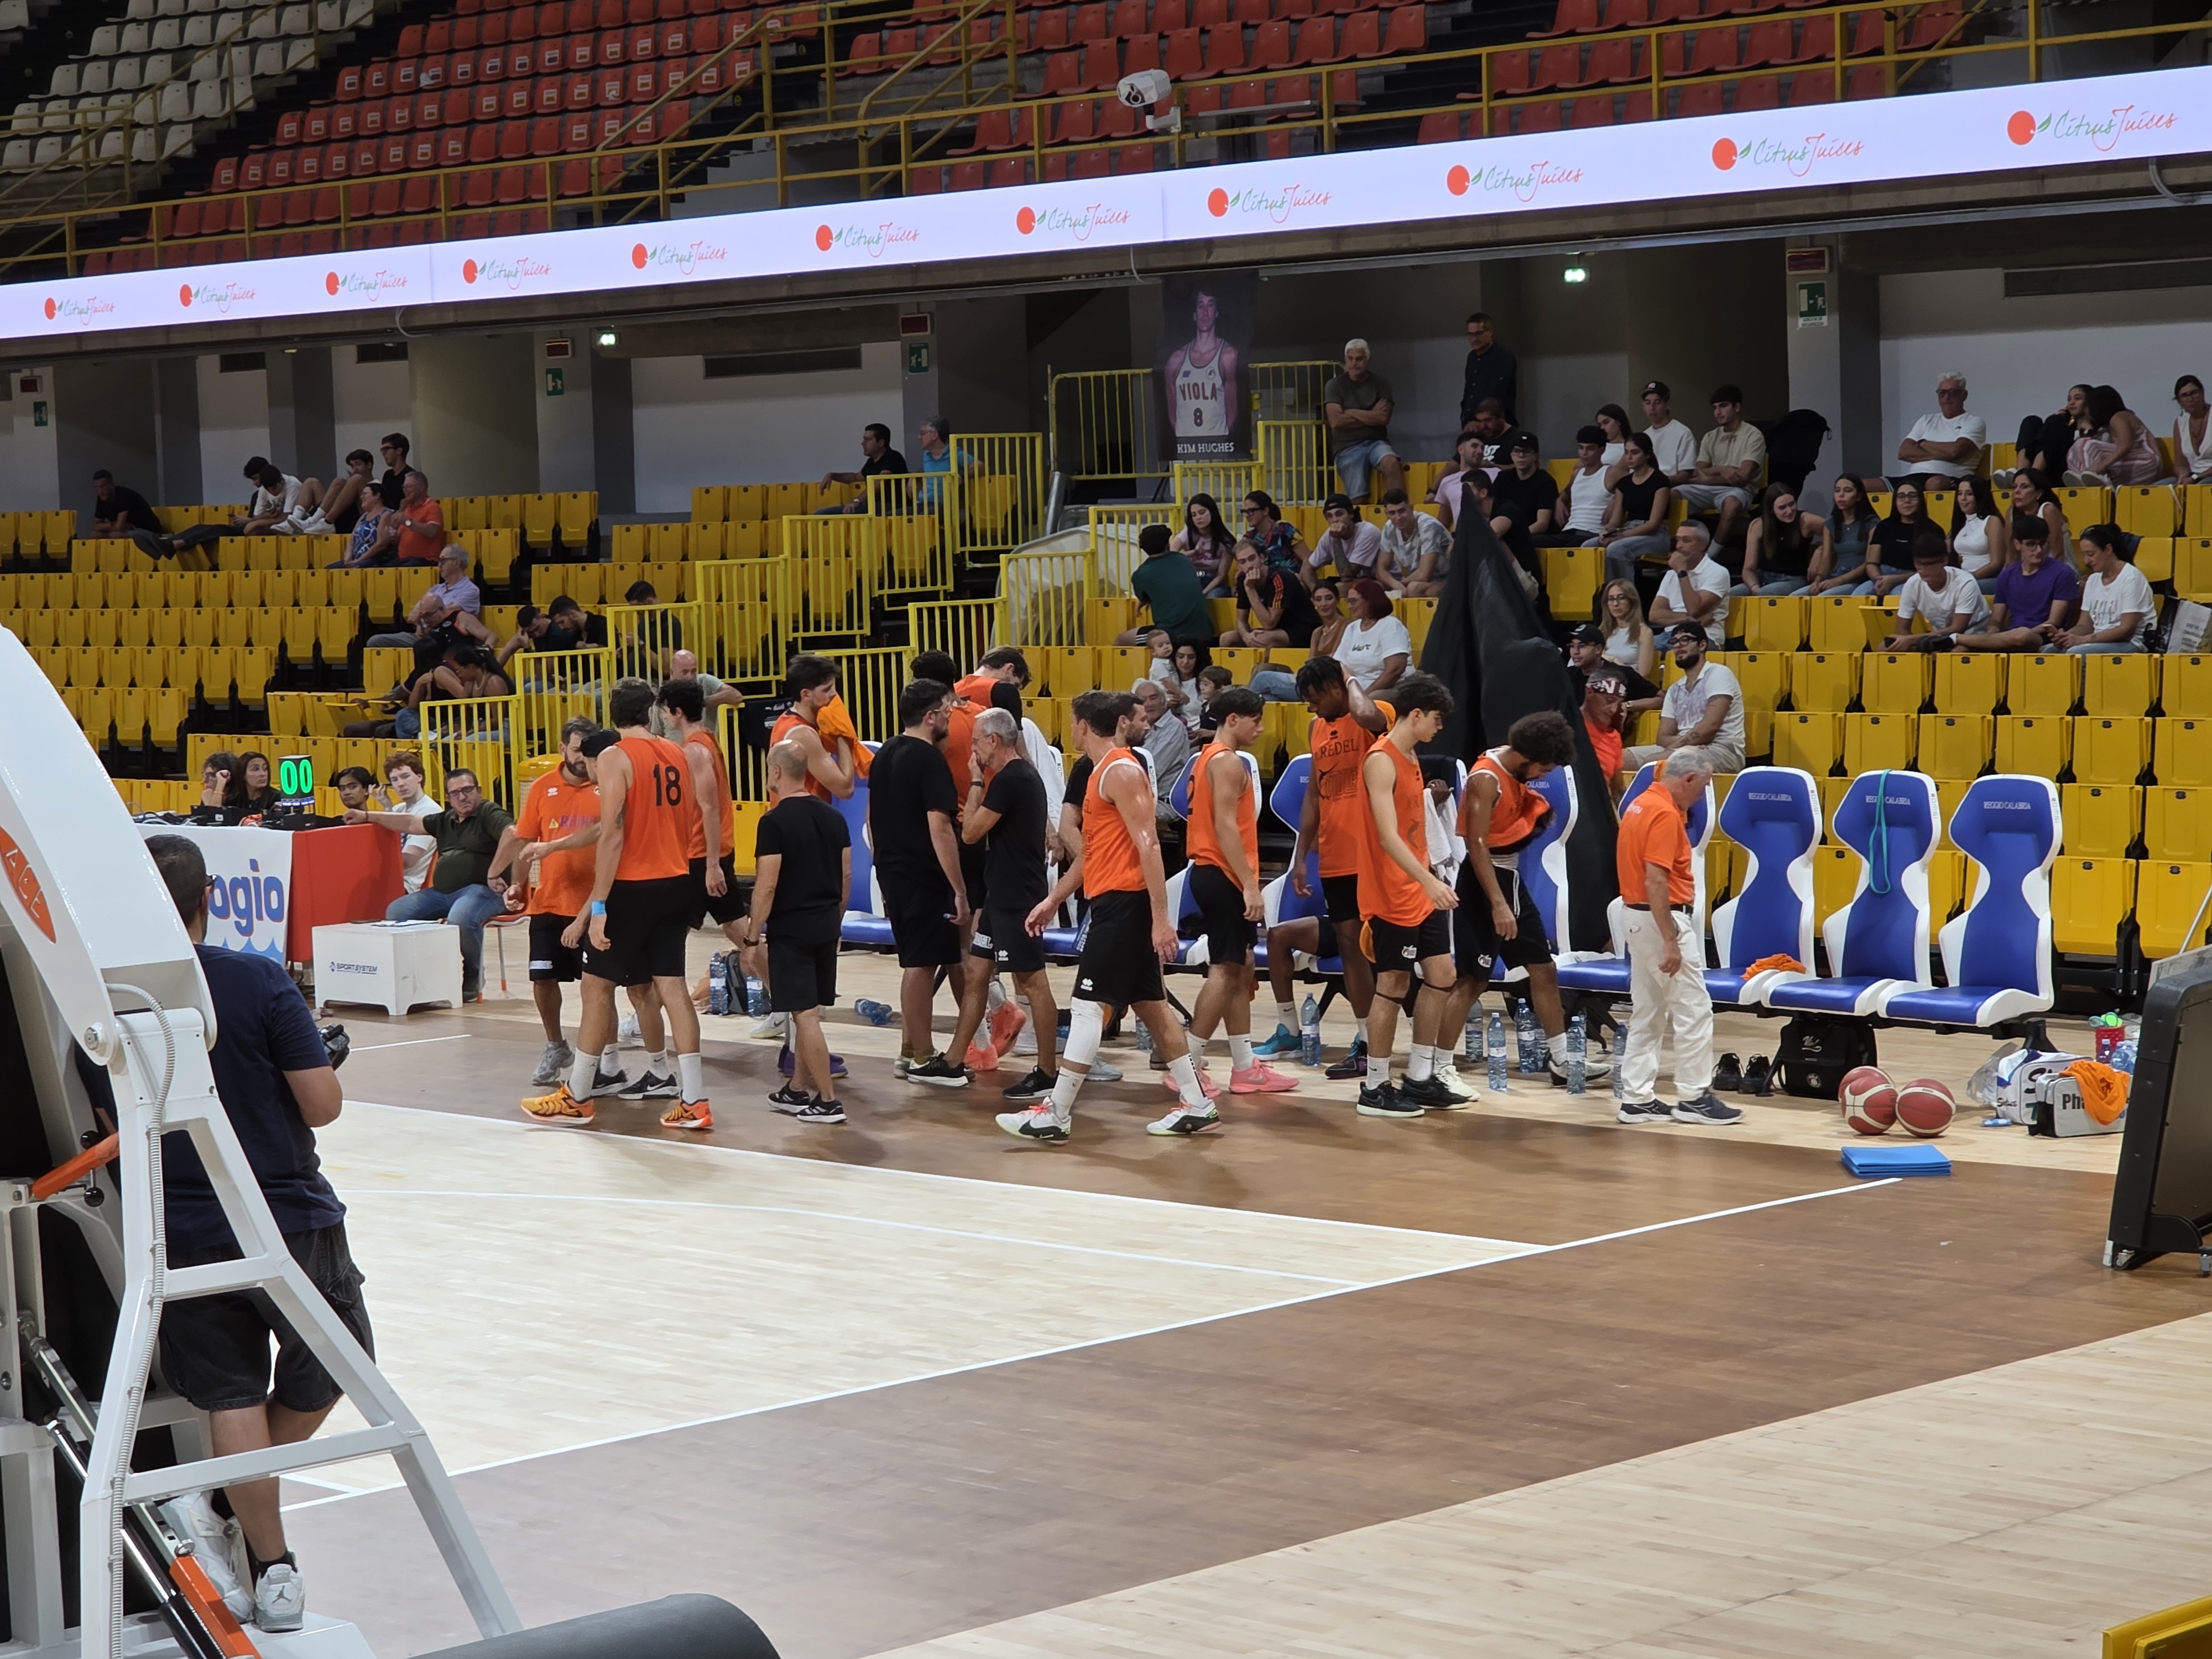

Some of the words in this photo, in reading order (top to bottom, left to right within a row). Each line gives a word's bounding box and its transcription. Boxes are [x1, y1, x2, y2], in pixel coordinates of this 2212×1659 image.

[1179, 382, 1218, 402] VIOLA
[1193, 408, 1203, 427] 8
[1177, 444, 1196, 453] KIM
[1198, 442, 1234, 453] HUGHES
[281, 759, 312, 795] 00
[653, 764, 682, 806] 18
[209, 858, 284, 937] ogio
